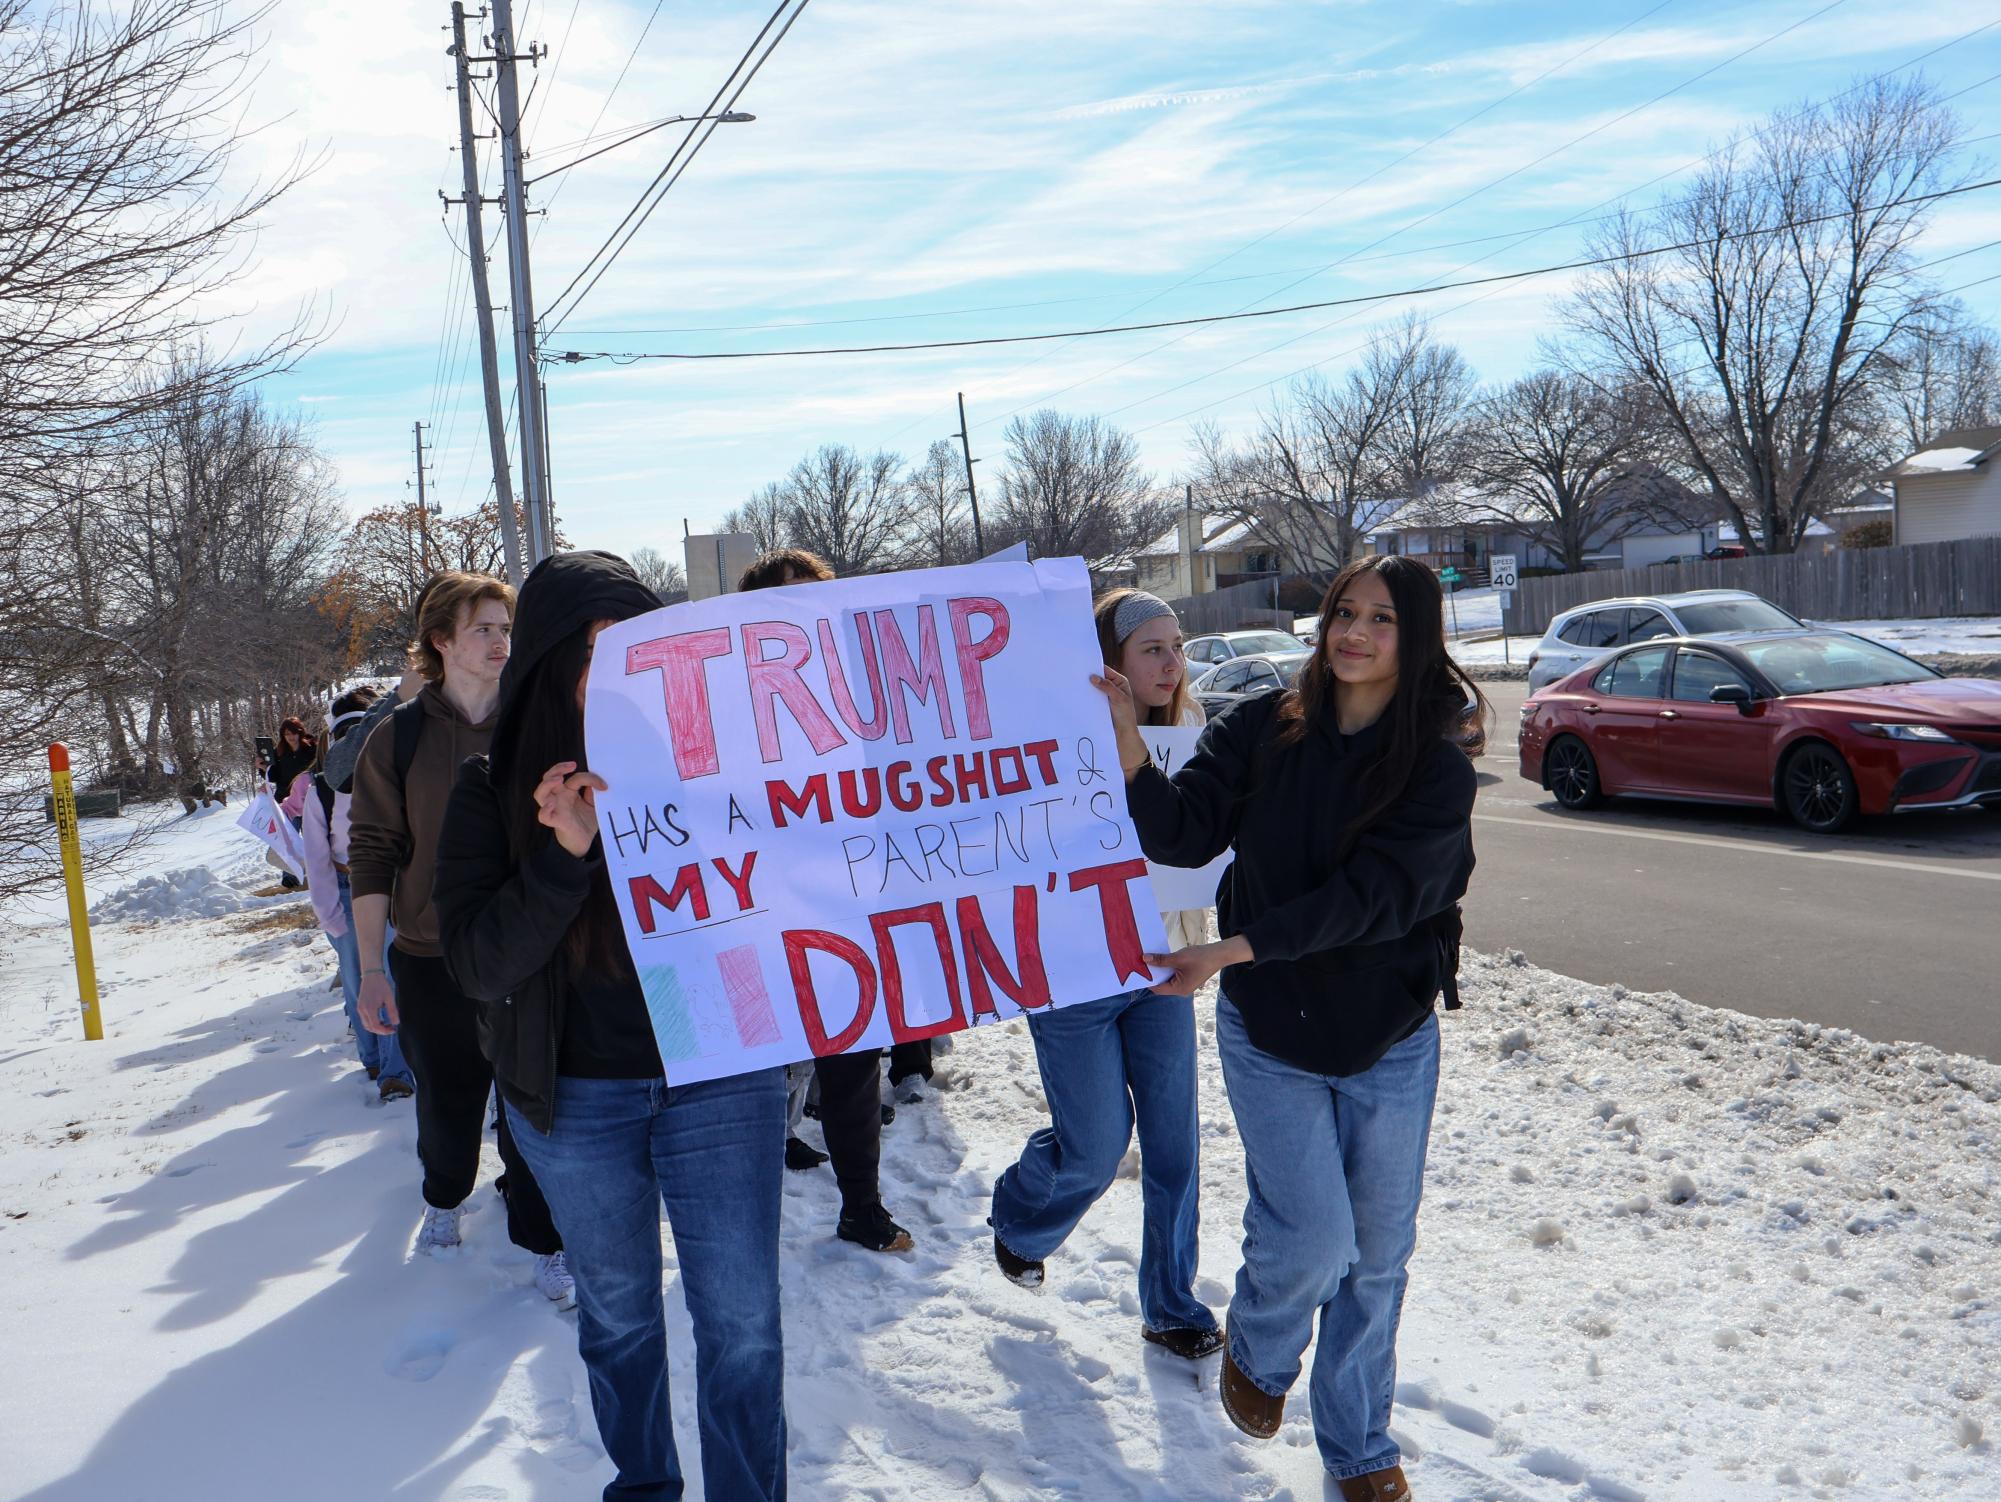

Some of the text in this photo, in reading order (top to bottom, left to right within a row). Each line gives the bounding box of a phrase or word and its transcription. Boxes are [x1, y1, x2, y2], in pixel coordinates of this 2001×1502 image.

[1494, 573, 1515, 586] 40
[625, 596, 1011, 781] TRUMP
[56, 793, 69, 841] WARNING
[608, 737, 1107, 858] HAS A MUGSHOT &
[628, 790, 1122, 934] MY PARENT'S
[780, 857, 1153, 1058] DON'T
